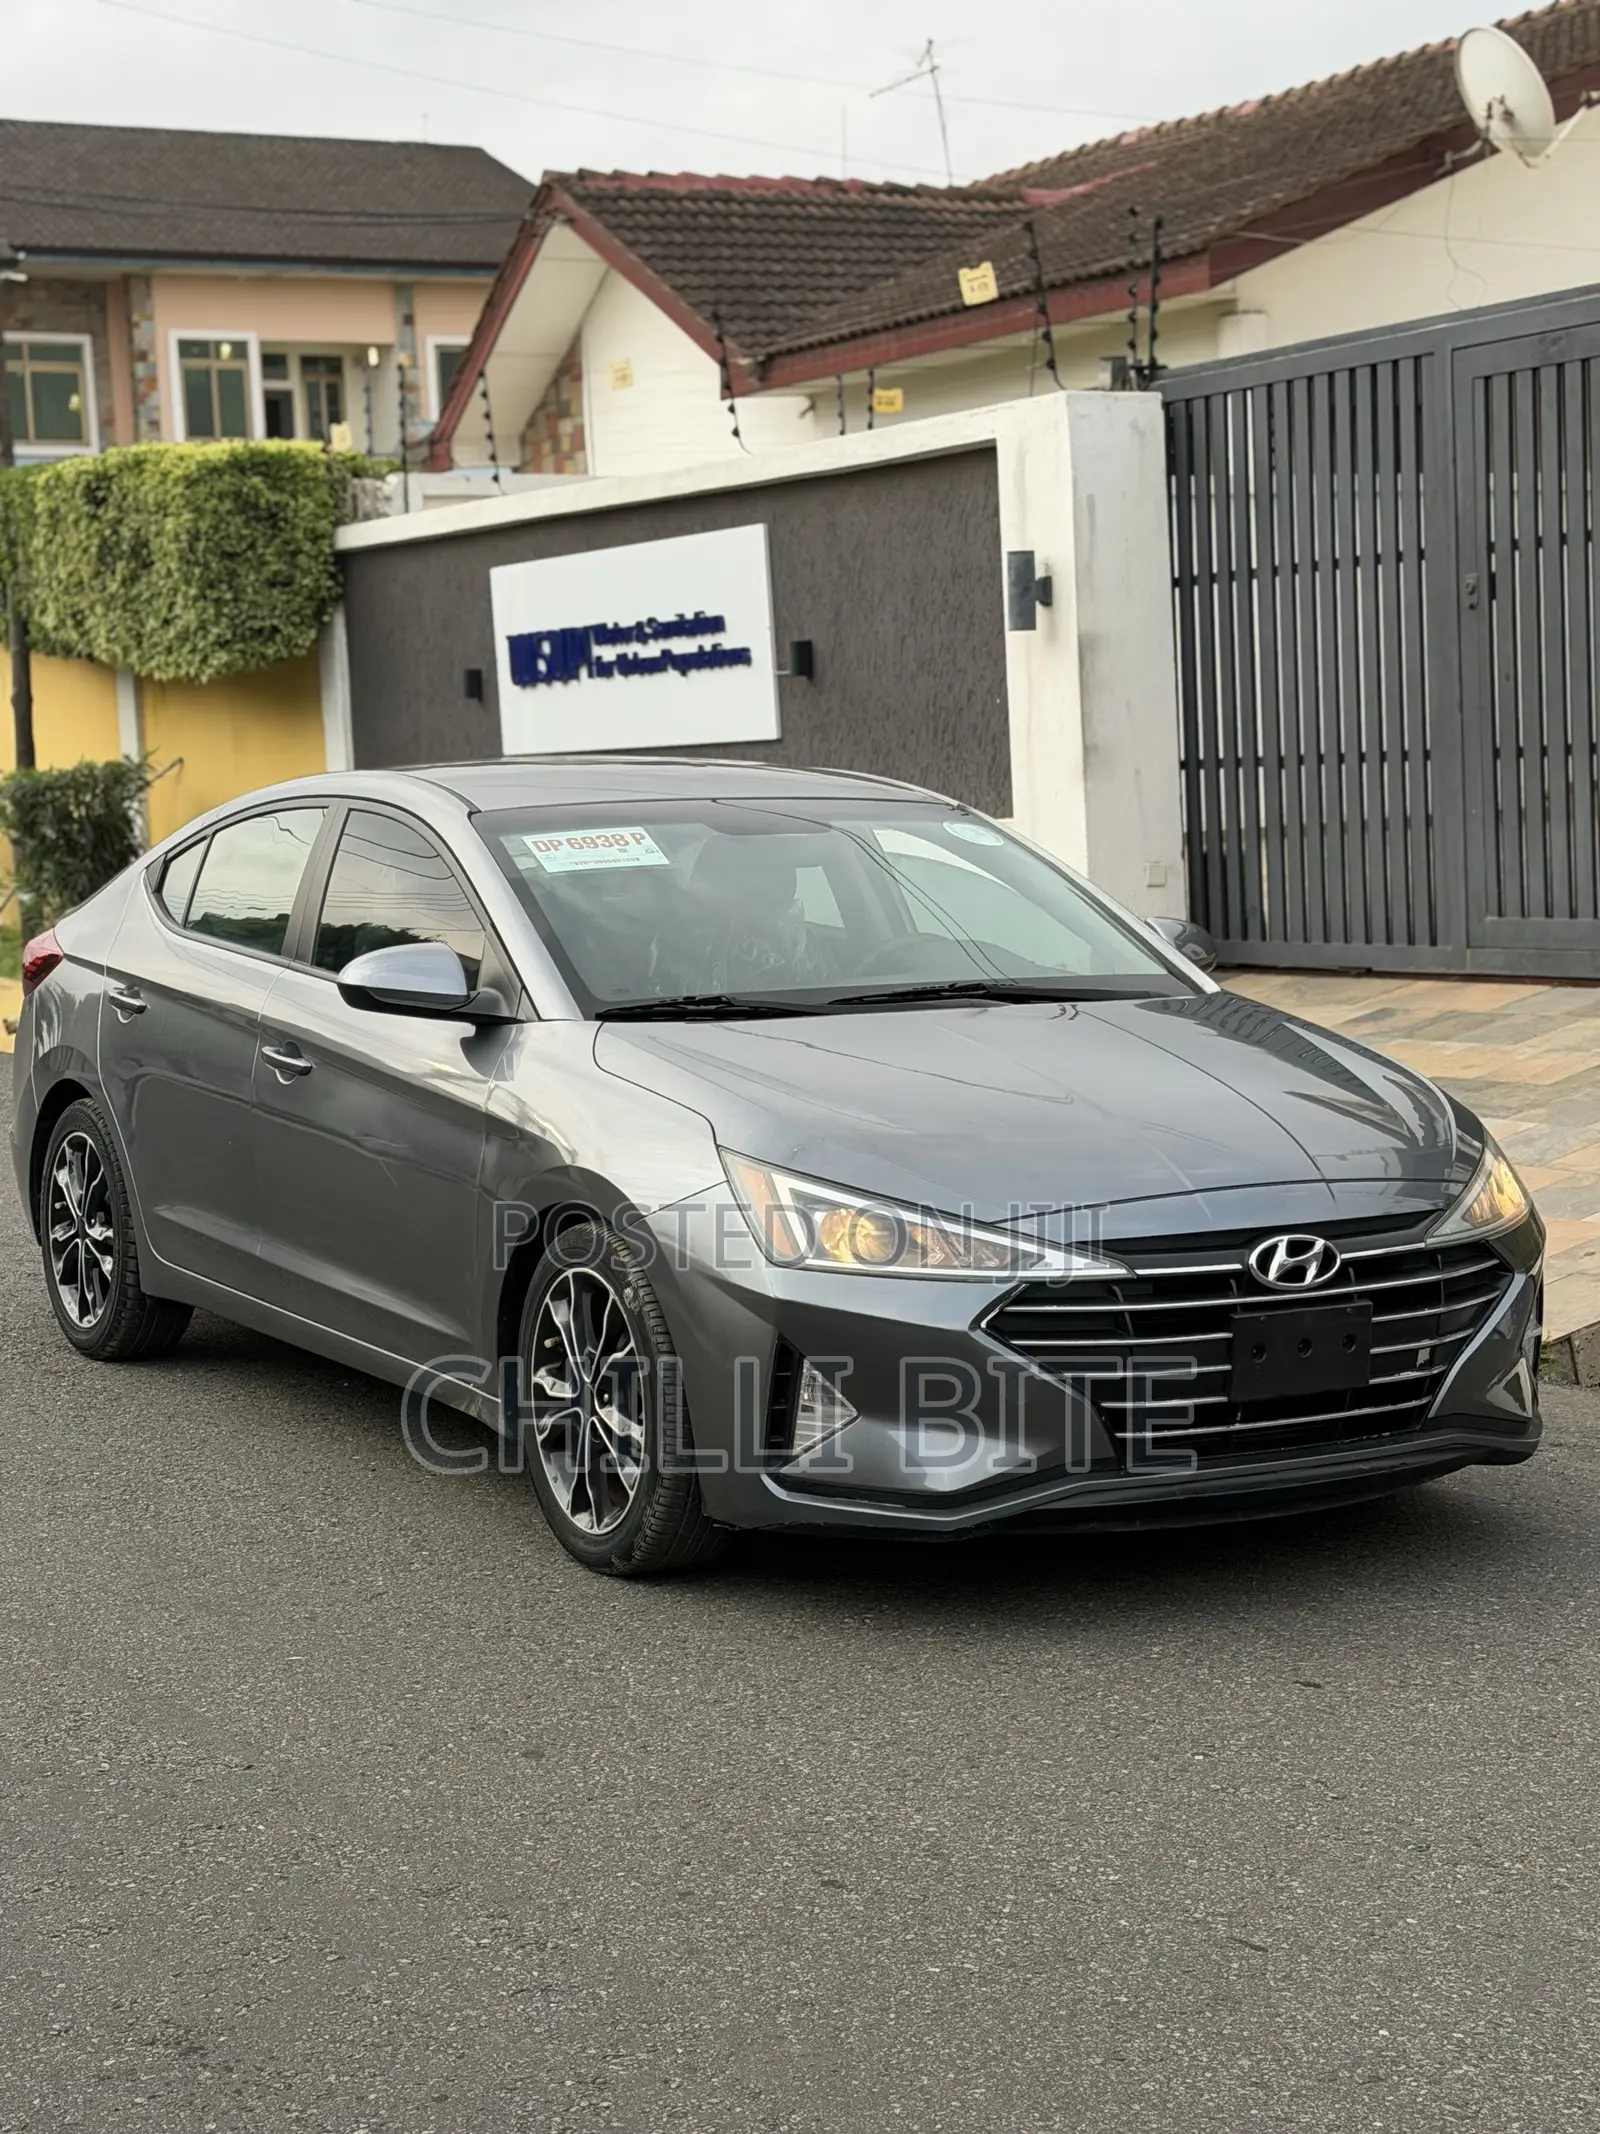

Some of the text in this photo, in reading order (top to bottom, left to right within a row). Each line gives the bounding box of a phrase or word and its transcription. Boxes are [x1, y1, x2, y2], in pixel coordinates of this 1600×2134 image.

[531, 839, 564, 853] DP
[565, 833, 630, 850] 6938
[629, 832, 646, 846] P
